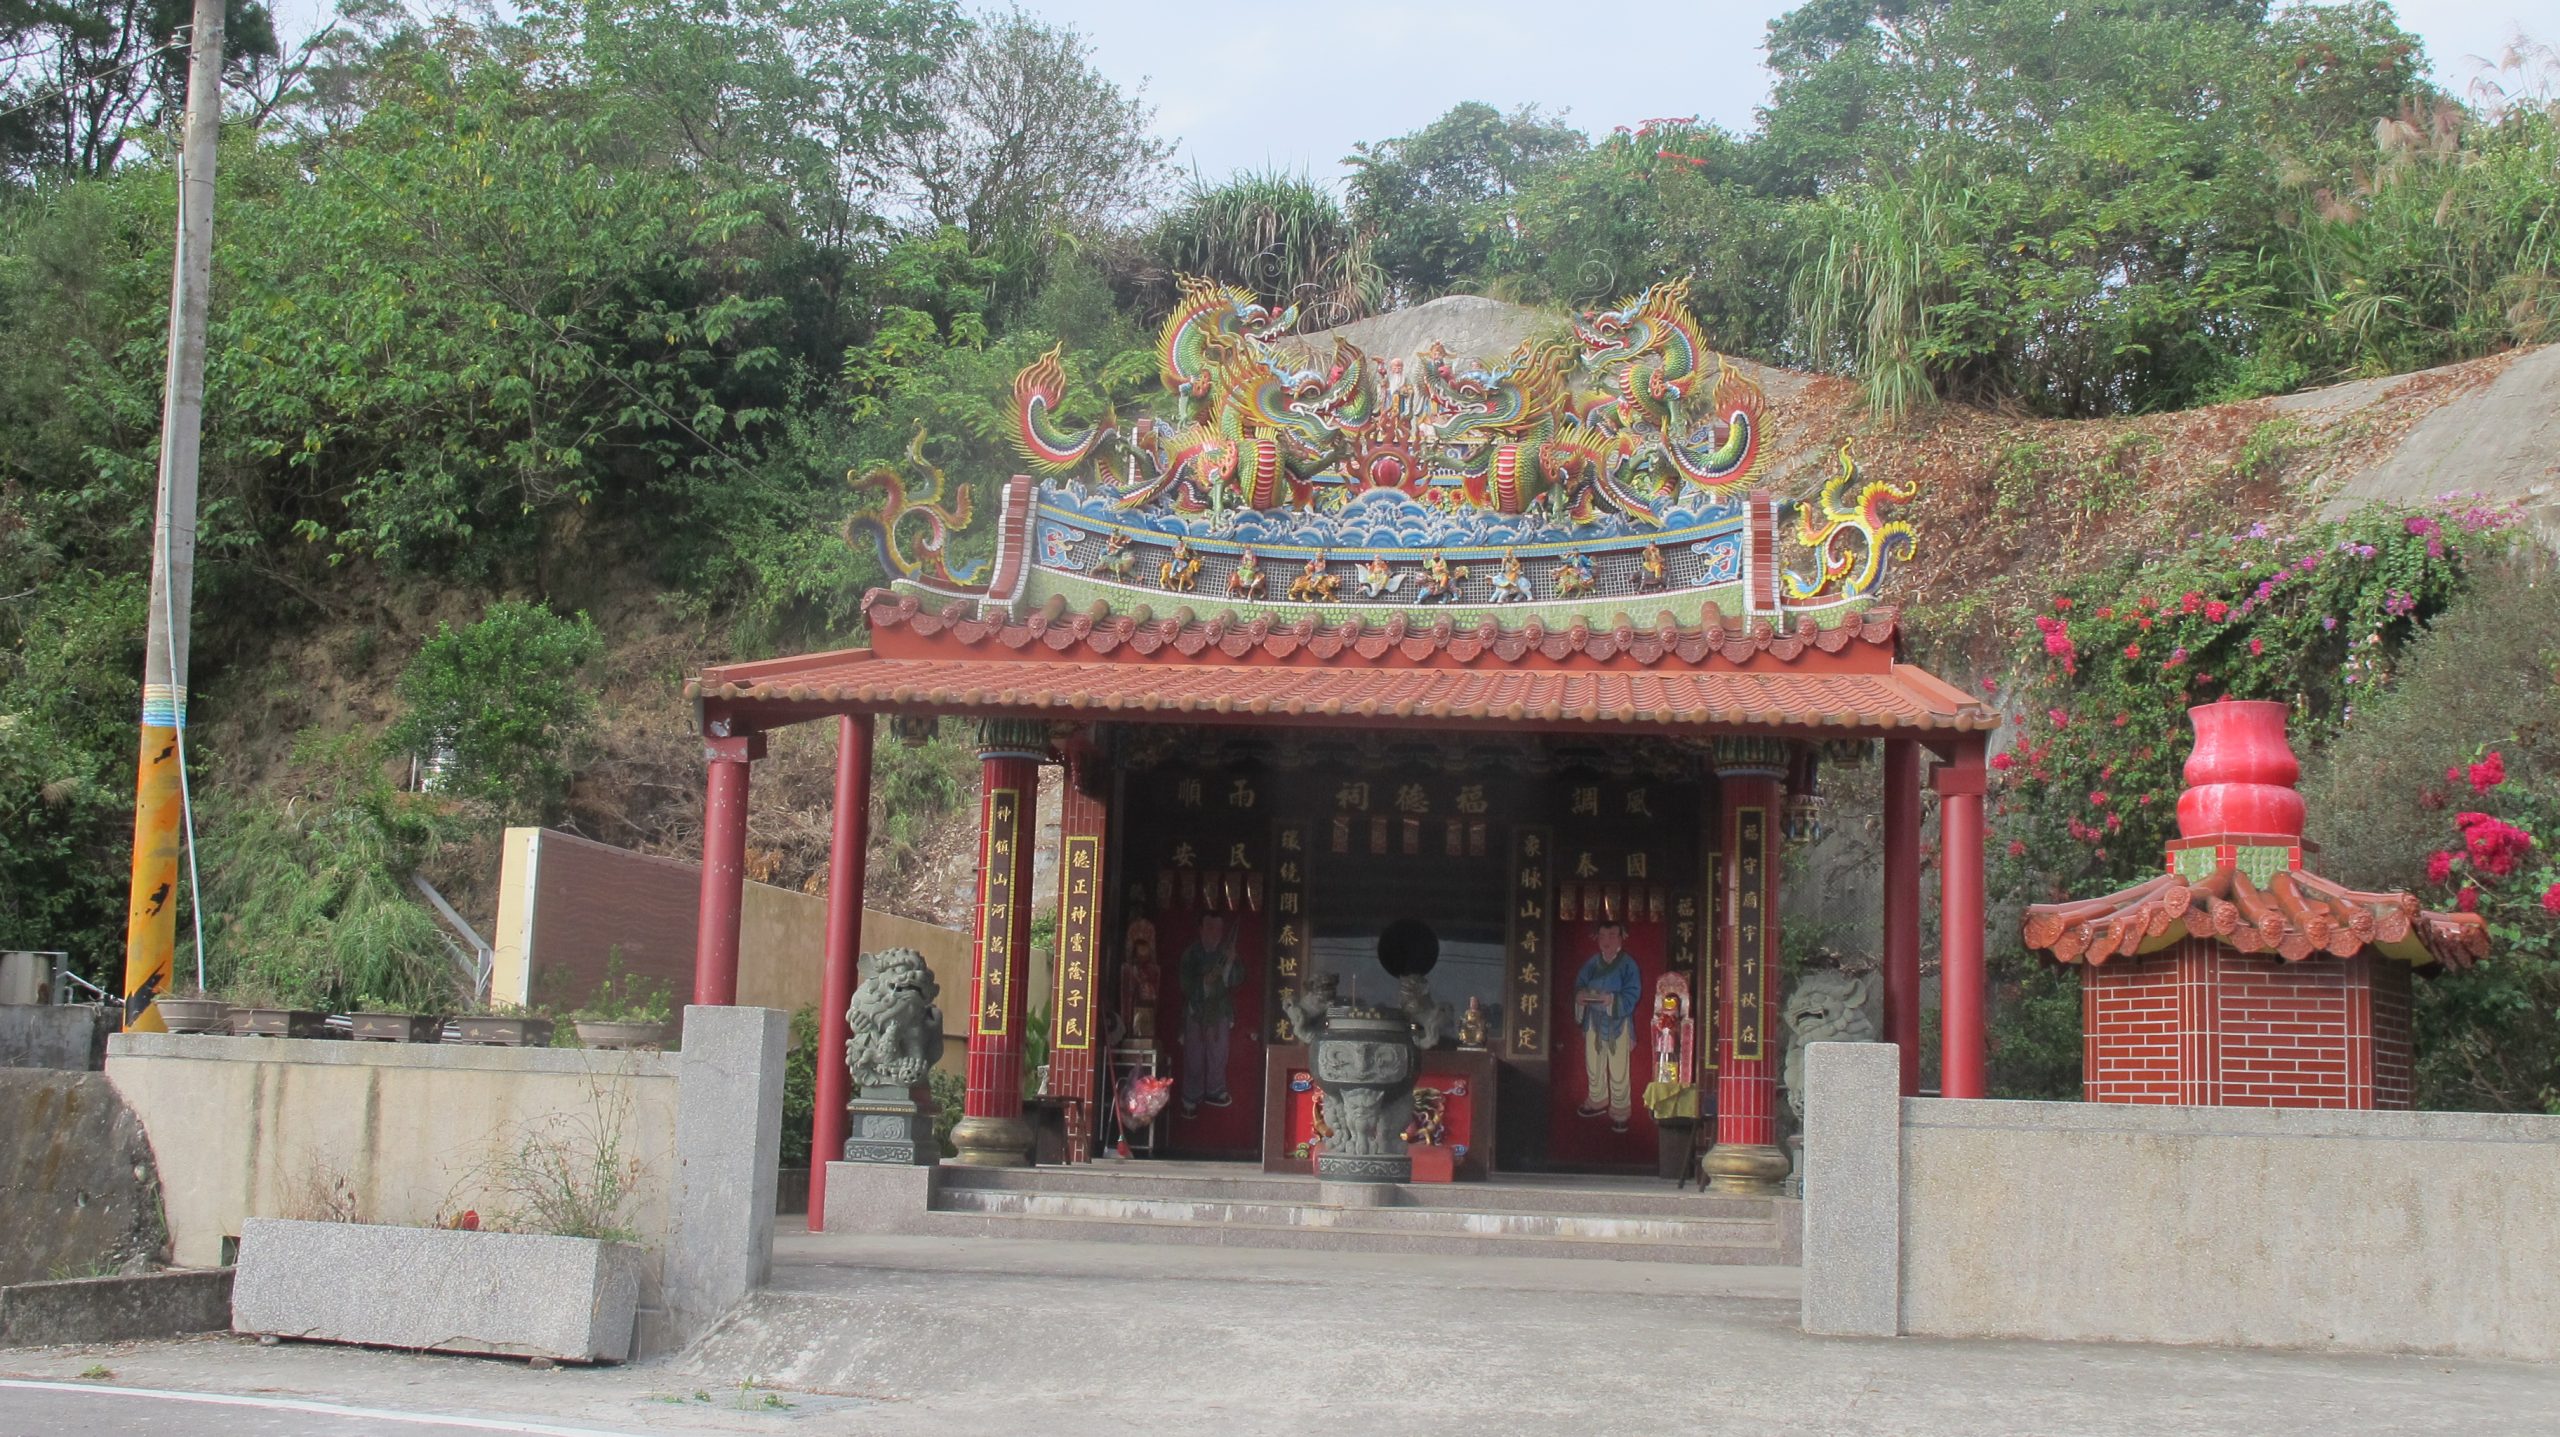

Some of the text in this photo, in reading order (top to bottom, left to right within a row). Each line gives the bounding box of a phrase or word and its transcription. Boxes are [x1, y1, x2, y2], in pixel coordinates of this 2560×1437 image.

[985, 806, 1012, 1018] 神鎮山河萬古安
